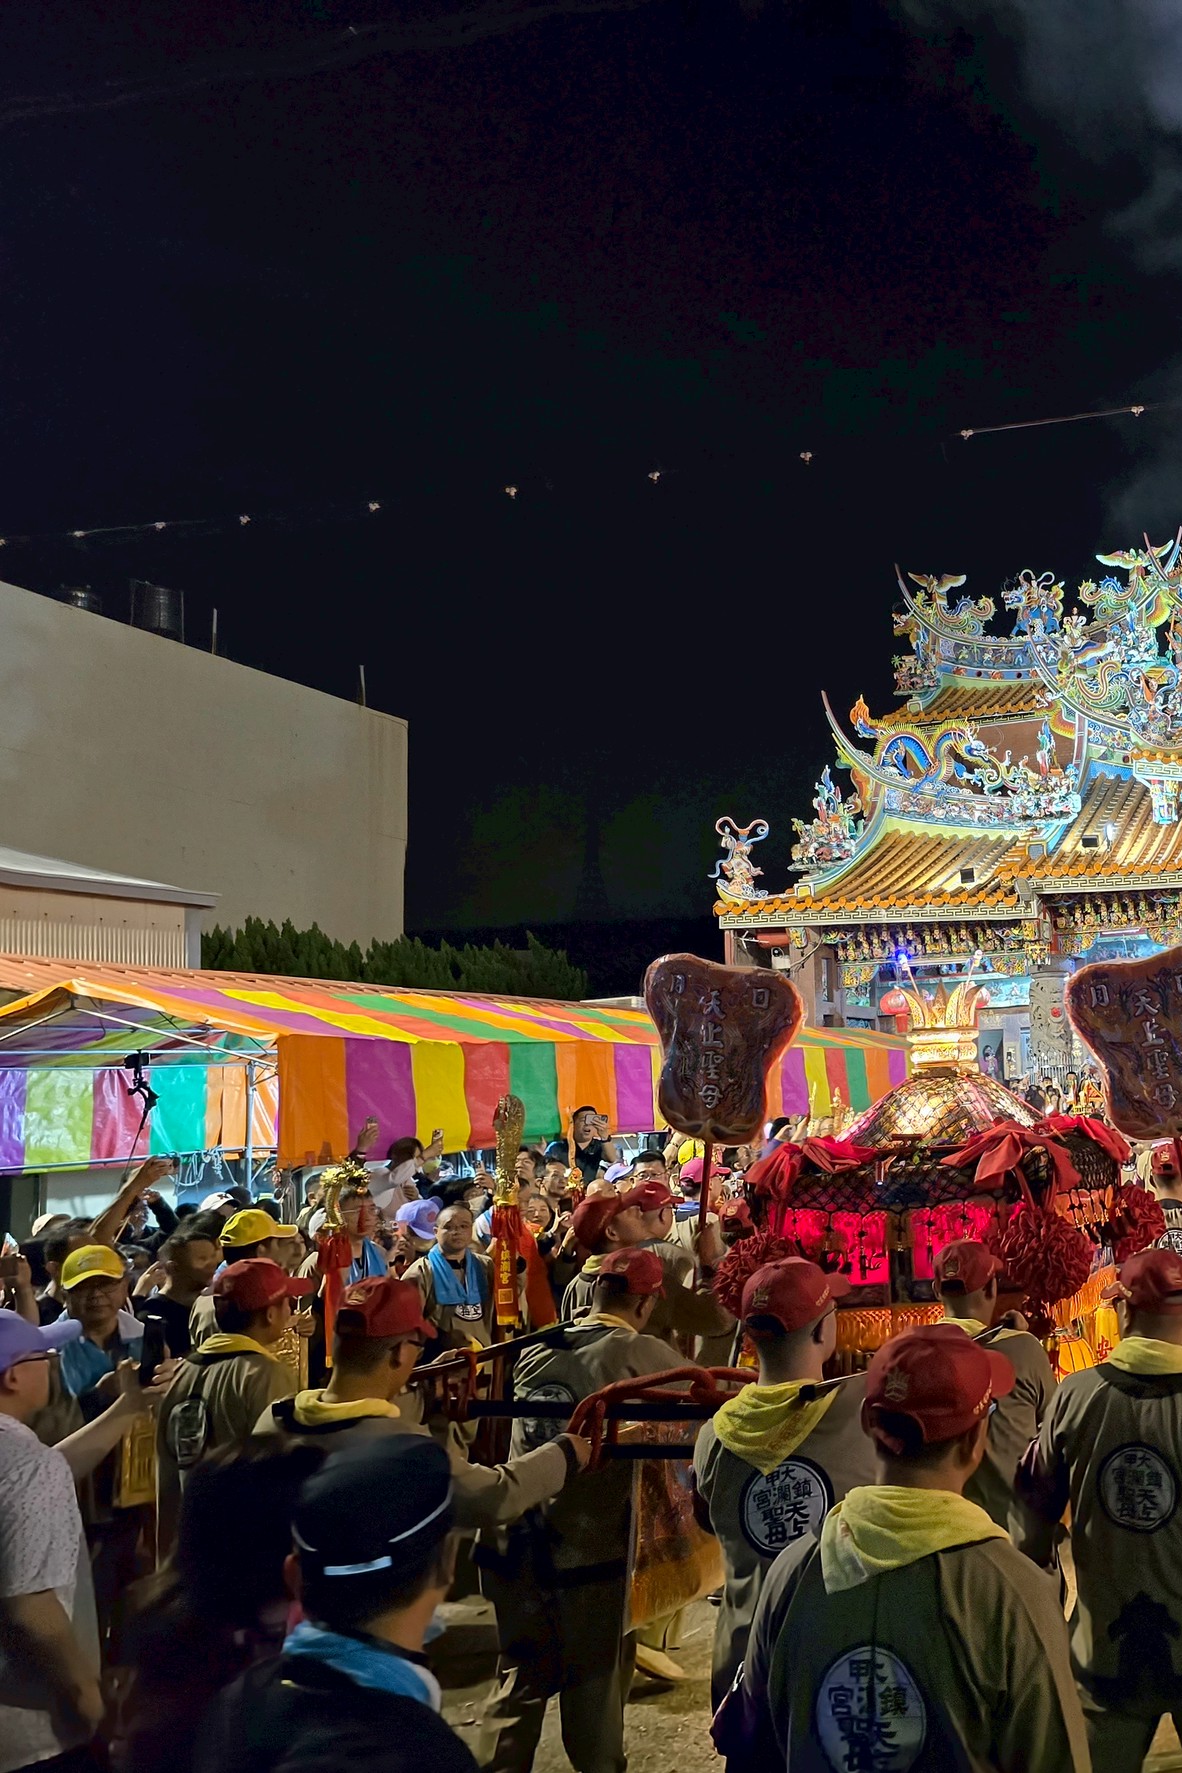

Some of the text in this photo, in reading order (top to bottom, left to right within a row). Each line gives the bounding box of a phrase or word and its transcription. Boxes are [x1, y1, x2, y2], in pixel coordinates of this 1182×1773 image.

[699, 989, 726, 1109] 天上聖母
[1134, 988, 1179, 1109] 天上聖母
[753, 1479, 813, 1512] 鎮瀾宮
